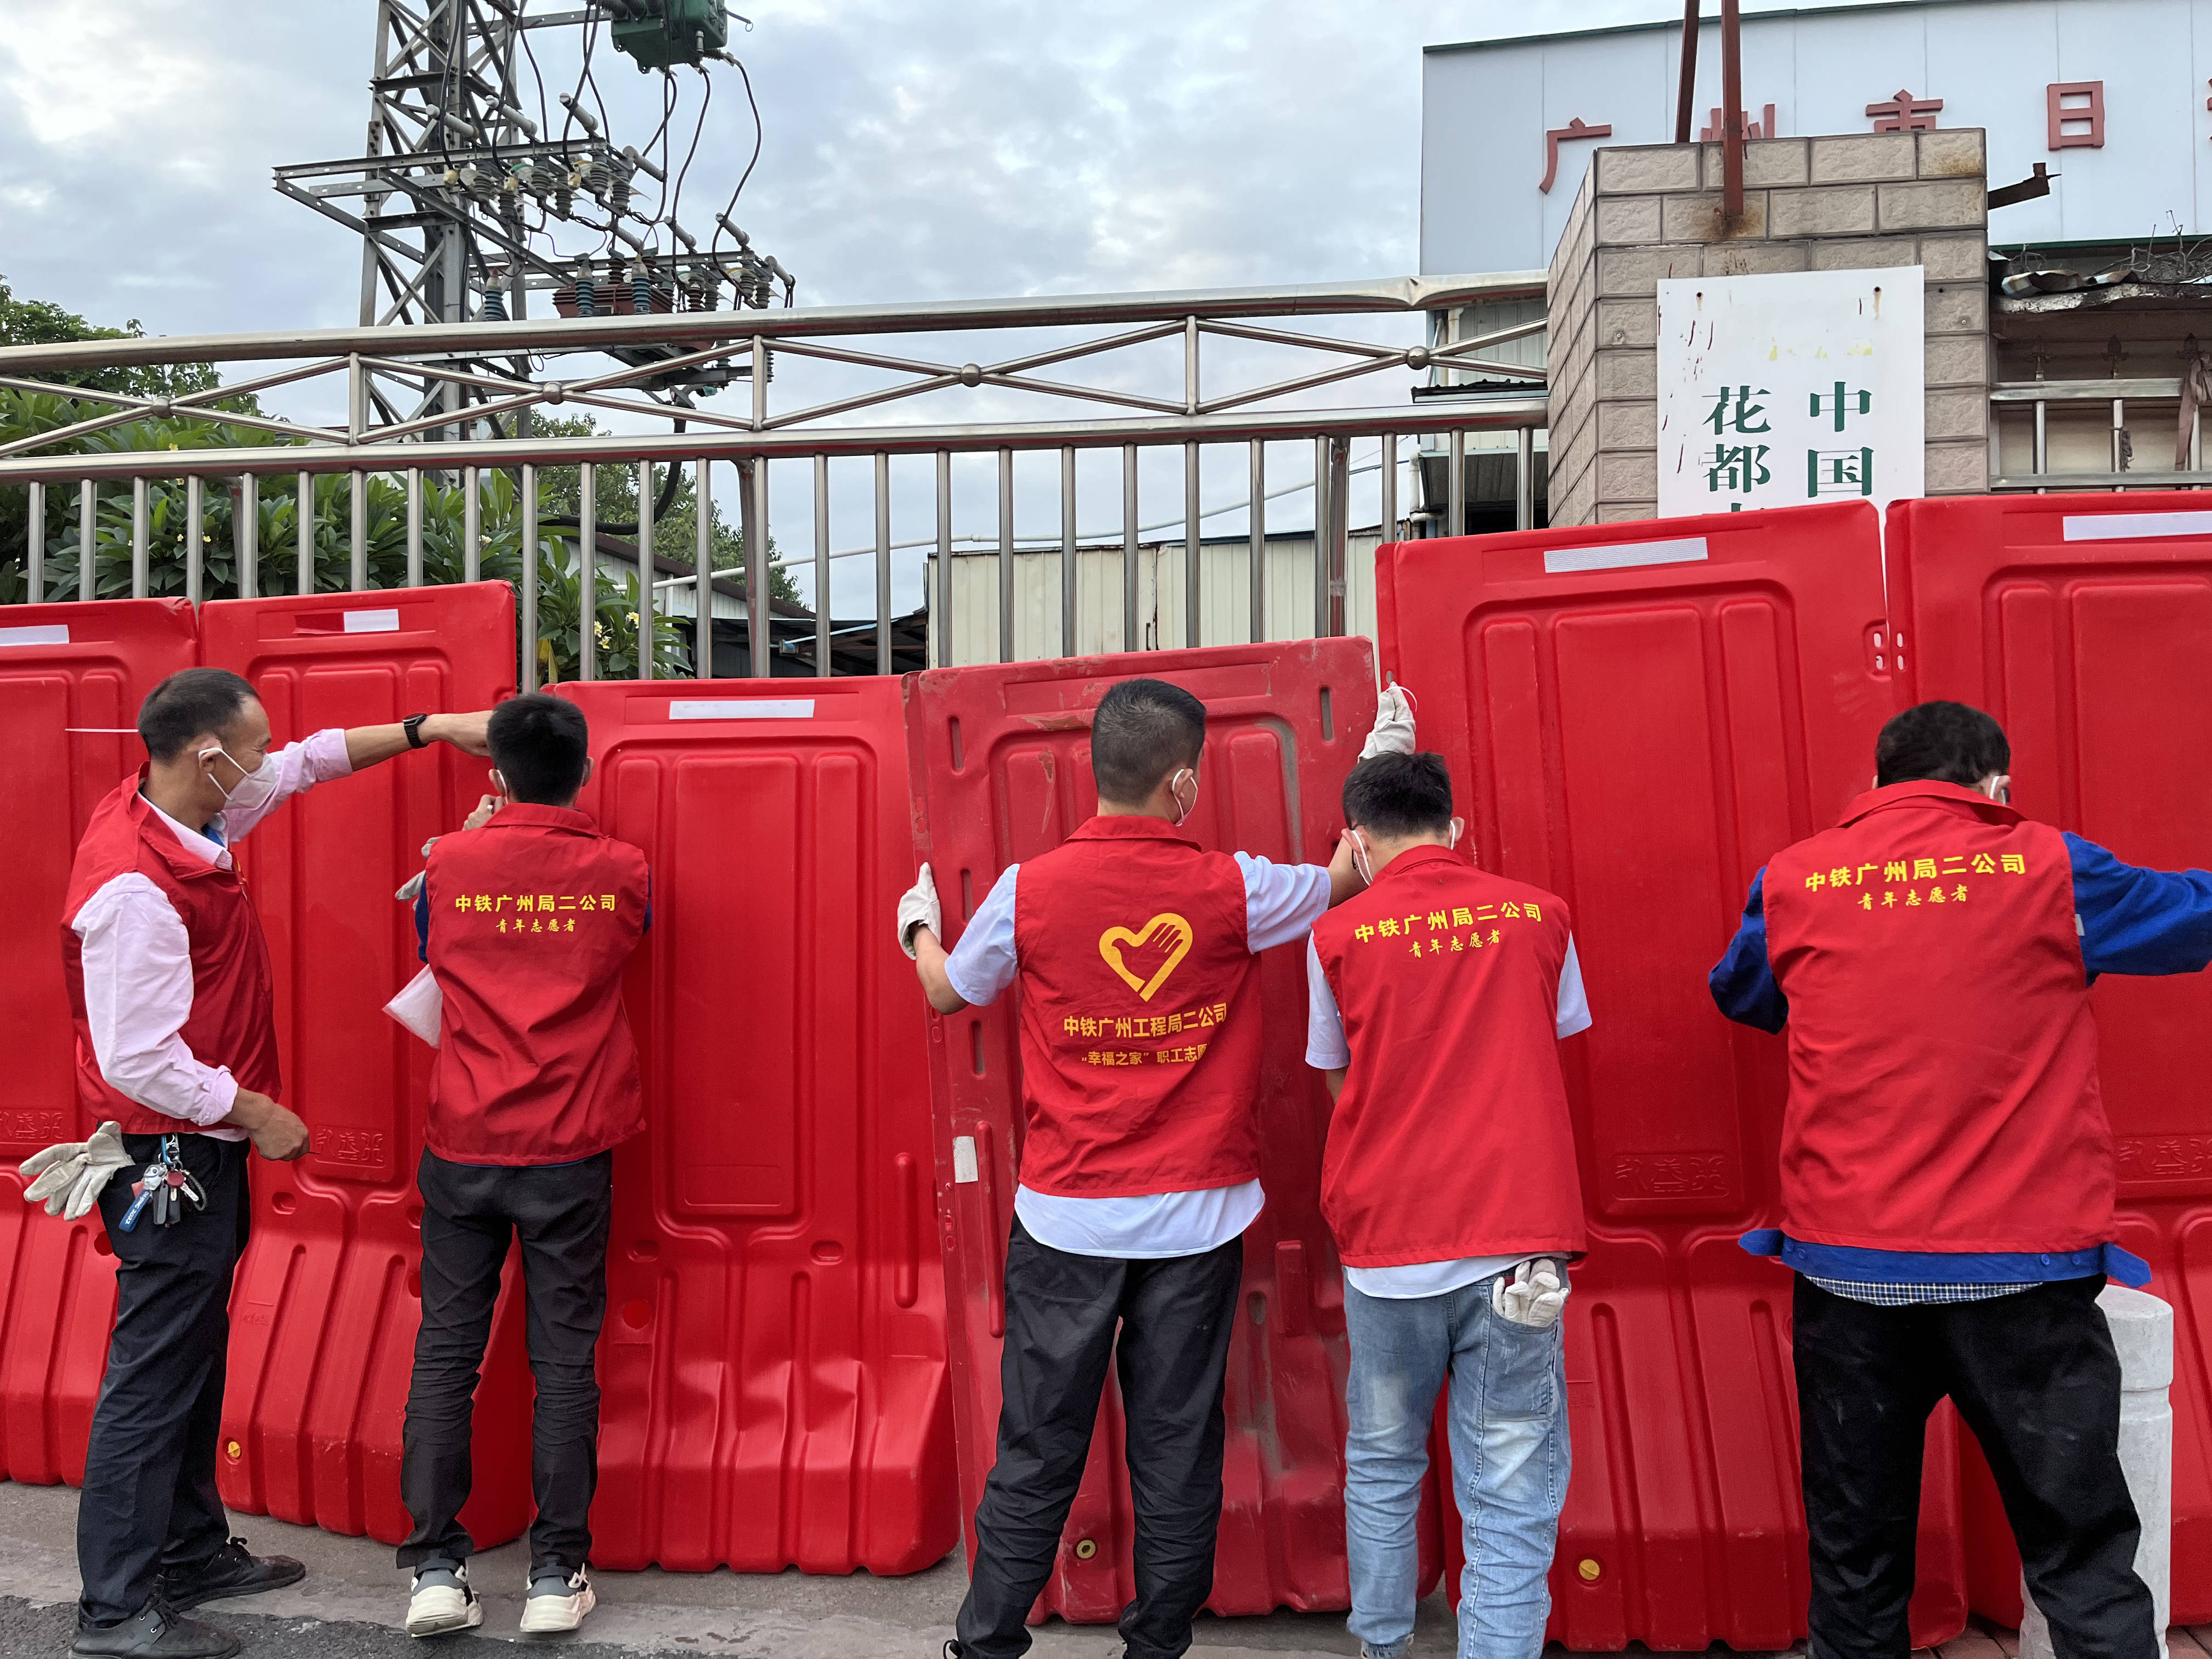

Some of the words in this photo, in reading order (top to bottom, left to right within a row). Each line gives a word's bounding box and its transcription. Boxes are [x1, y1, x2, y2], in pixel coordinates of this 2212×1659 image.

[1701, 385, 1771, 514] 花都
[1808, 381, 1874, 498] 中国
[1804, 853, 2026, 893] 中铁广州局二公司
[455, 894, 616, 912] 中铁广州局二公司
[1857, 883, 1969, 911] 青年志愿者
[495, 918, 576, 933] 青年志愿者
[1354, 901, 1542, 943] 中铁广州局二公司
[1408, 928, 1501, 958] 青年志愿者
[1064, 1002, 1227, 1039] 中铁广州工程局二公司
[125, 1209, 137, 1225] 2022
